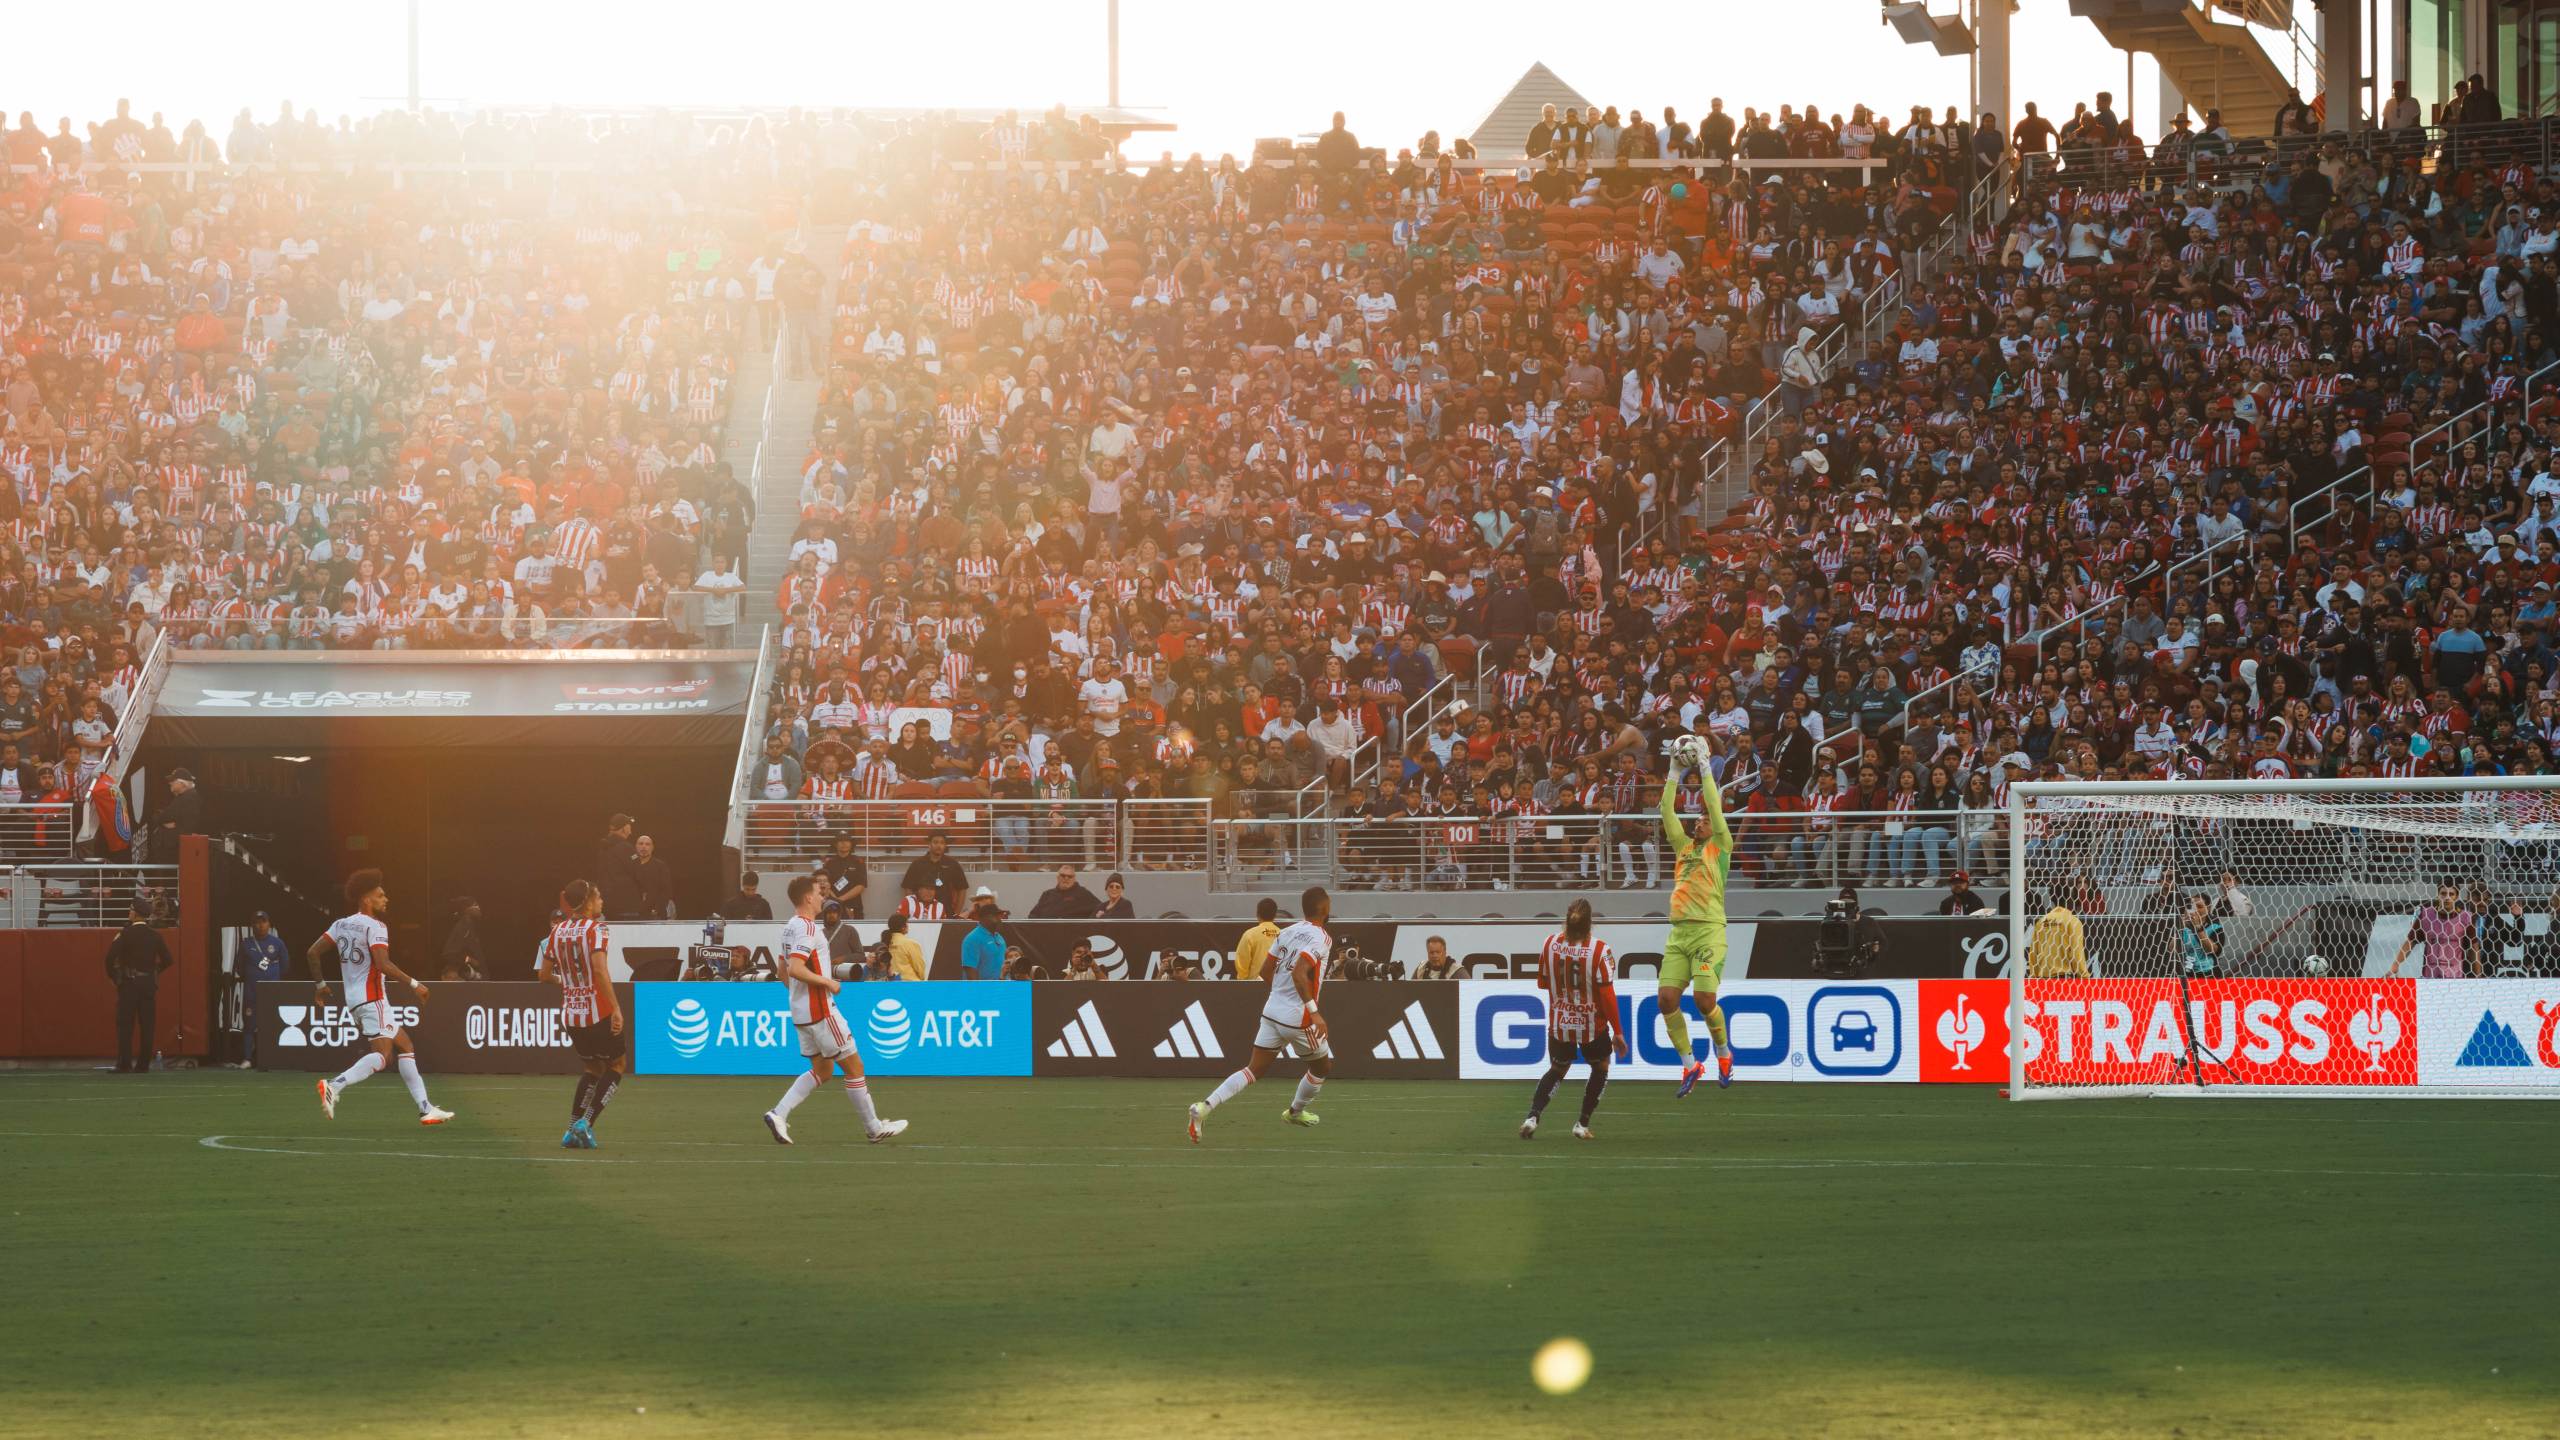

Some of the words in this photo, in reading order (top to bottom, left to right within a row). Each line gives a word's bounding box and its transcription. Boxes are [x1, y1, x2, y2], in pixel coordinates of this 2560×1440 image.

[258, 699, 354, 708] CUP
[262, 690, 473, 701] LEAGUES
[553, 699, 709, 712] STADIUM
[911, 808, 946, 825] 146
[1448, 825, 1473, 842] 101
[336, 935, 365, 965] 26
[1551, 943, 1590, 957] OMNILIFE
[716, 1009, 792, 1048] AT&T
[918, 1009, 1000, 1048] AT&T
[1560, 1016, 1586, 1026] AXEN
[309, 1026, 360, 1047] CUP
[2003, 999, 2331, 1065] STRAUSS
